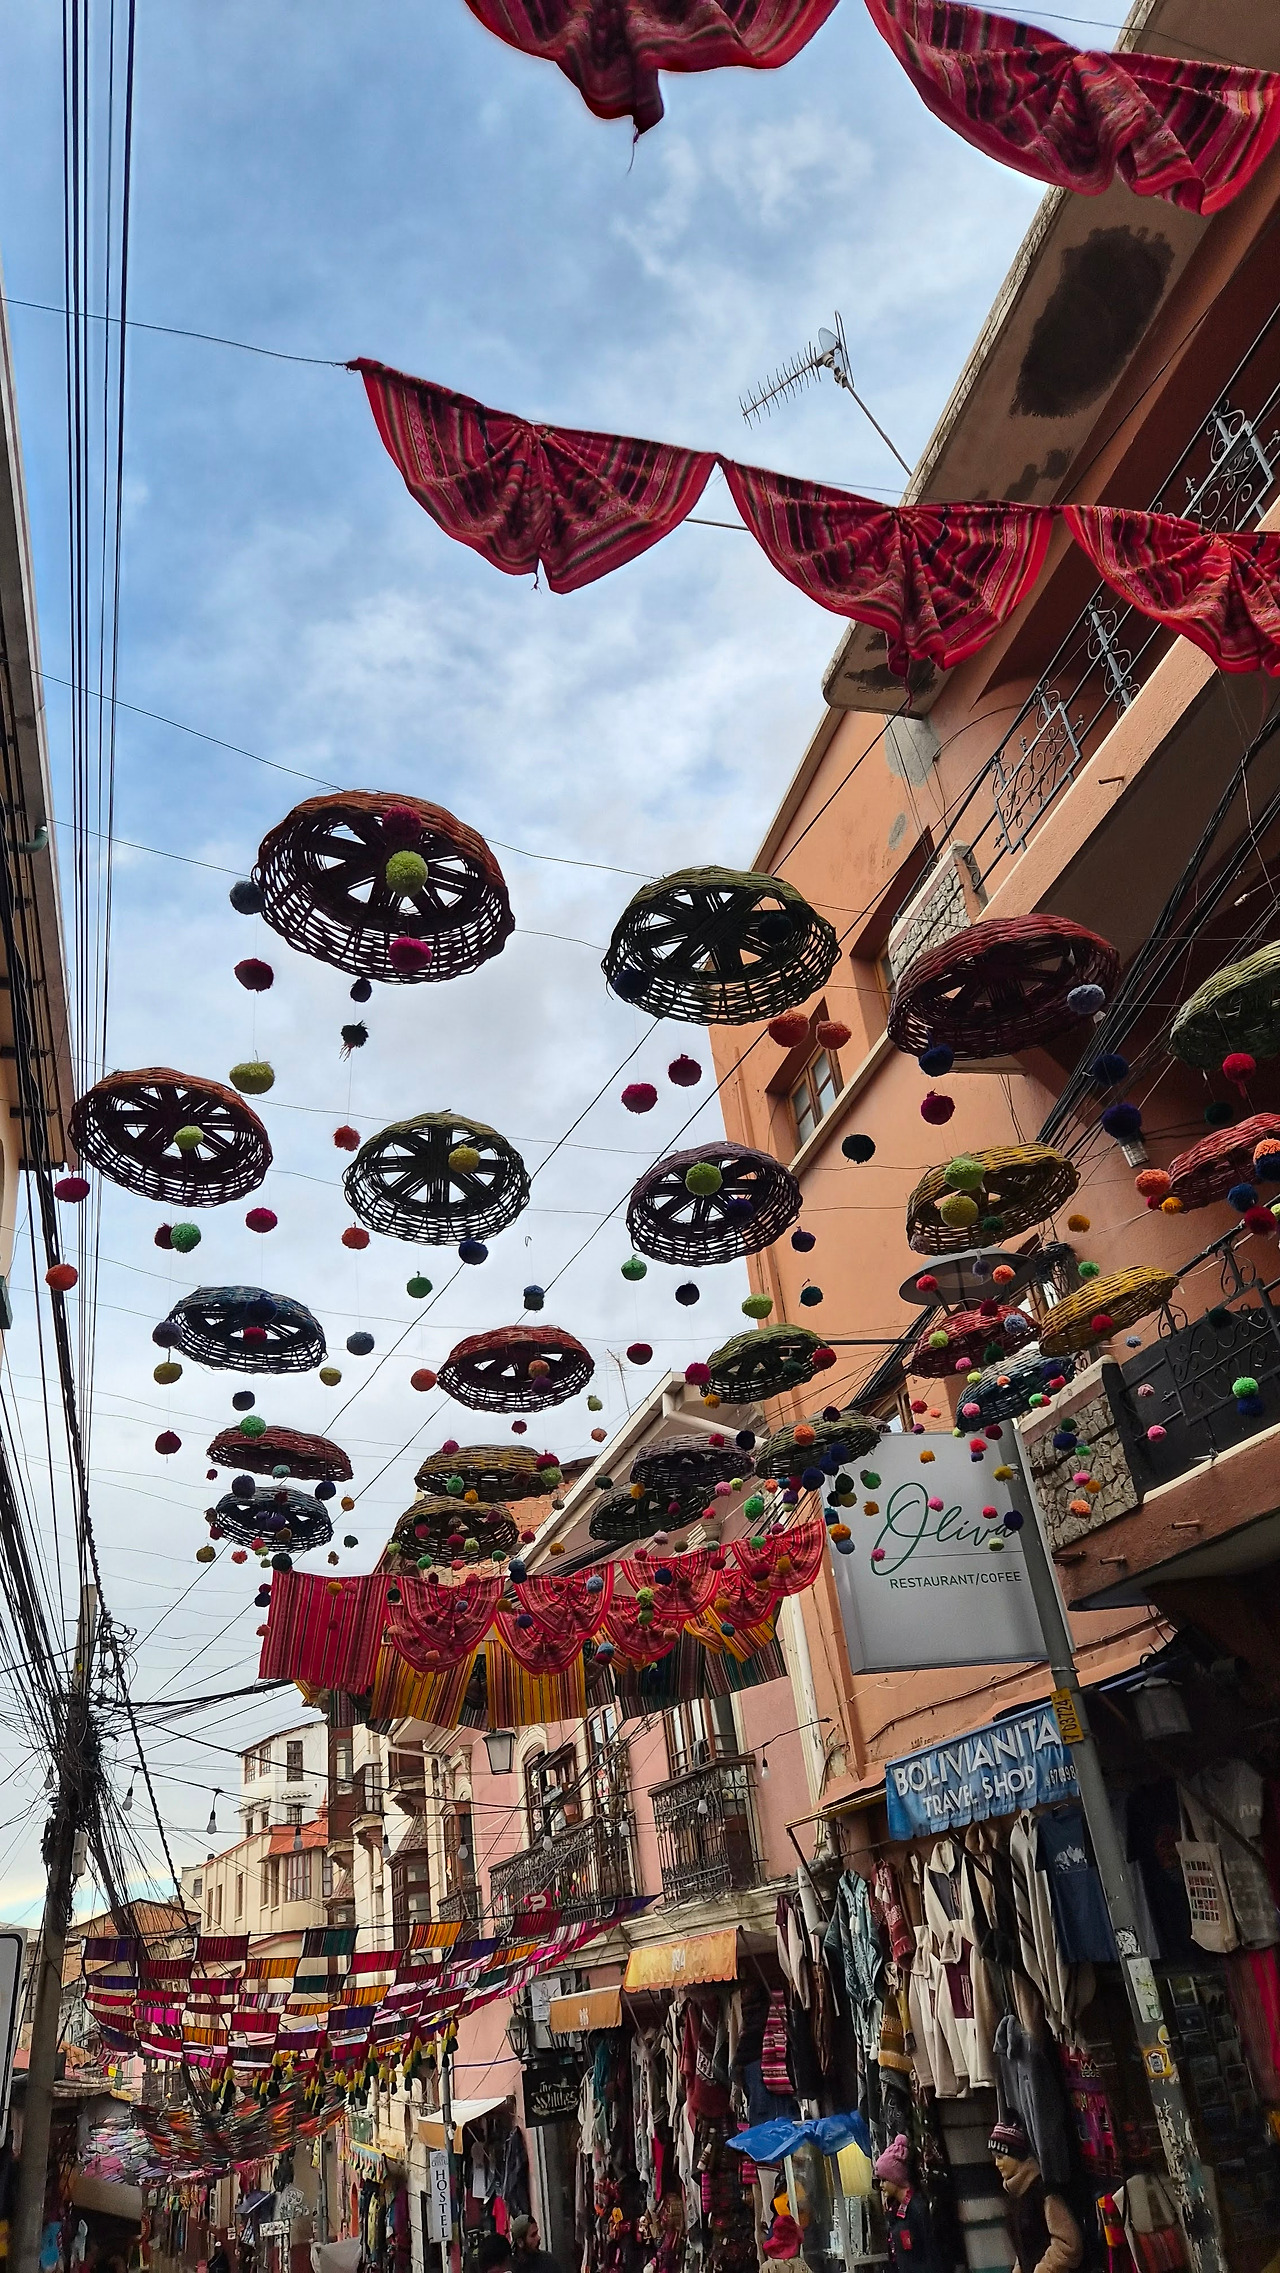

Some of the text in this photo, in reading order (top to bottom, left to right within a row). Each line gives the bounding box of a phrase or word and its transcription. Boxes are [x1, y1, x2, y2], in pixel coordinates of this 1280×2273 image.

[871, 1482, 1017, 1576] Oliva
[889, 1571, 1022, 1589] RESTAURANT/COFEE
[892, 1715, 1062, 1797] BOLIVIANITA
[923, 1765, 1037, 1819] TRAVEL SHOP
[435, 2170, 448, 2238] HOSTEL
